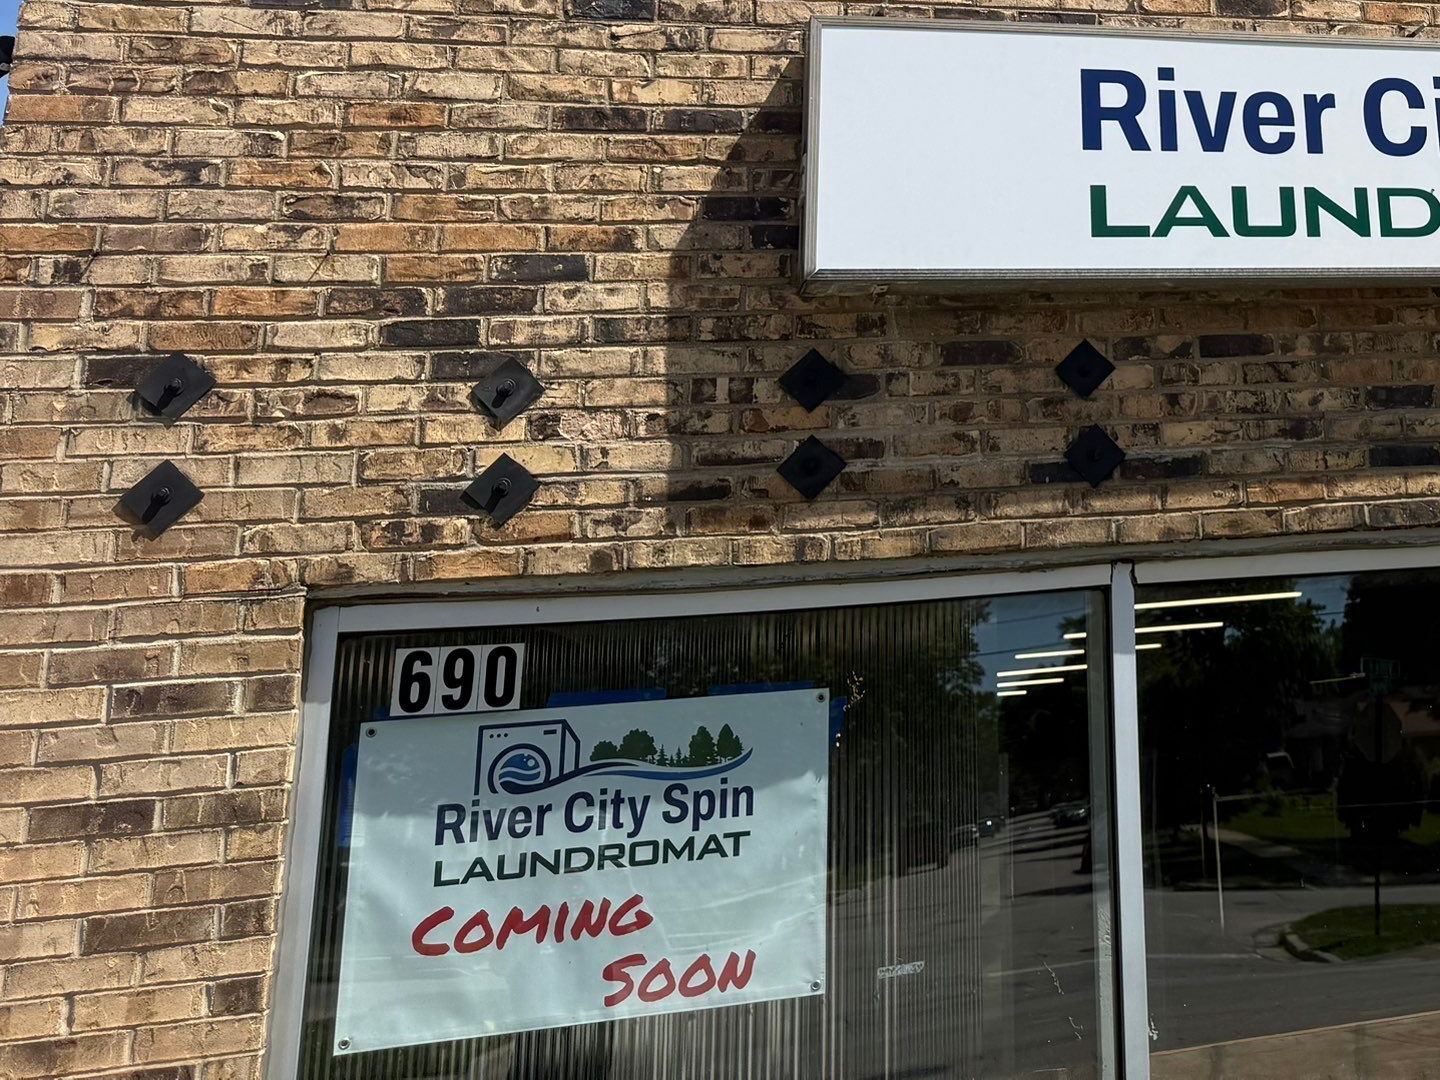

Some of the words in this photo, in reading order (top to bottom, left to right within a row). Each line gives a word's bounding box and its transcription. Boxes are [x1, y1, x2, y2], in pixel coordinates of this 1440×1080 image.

[1080, 67, 1336, 155] River
[398, 645, 518, 714] 690
[433, 798, 553, 847] River
[563, 787, 652, 839] City
[661, 776, 755, 832] Spin
[432, 830, 752, 888] LAUNDROMAT
[411, 893, 654, 957] COMING
[602, 949, 757, 1008] SOON
